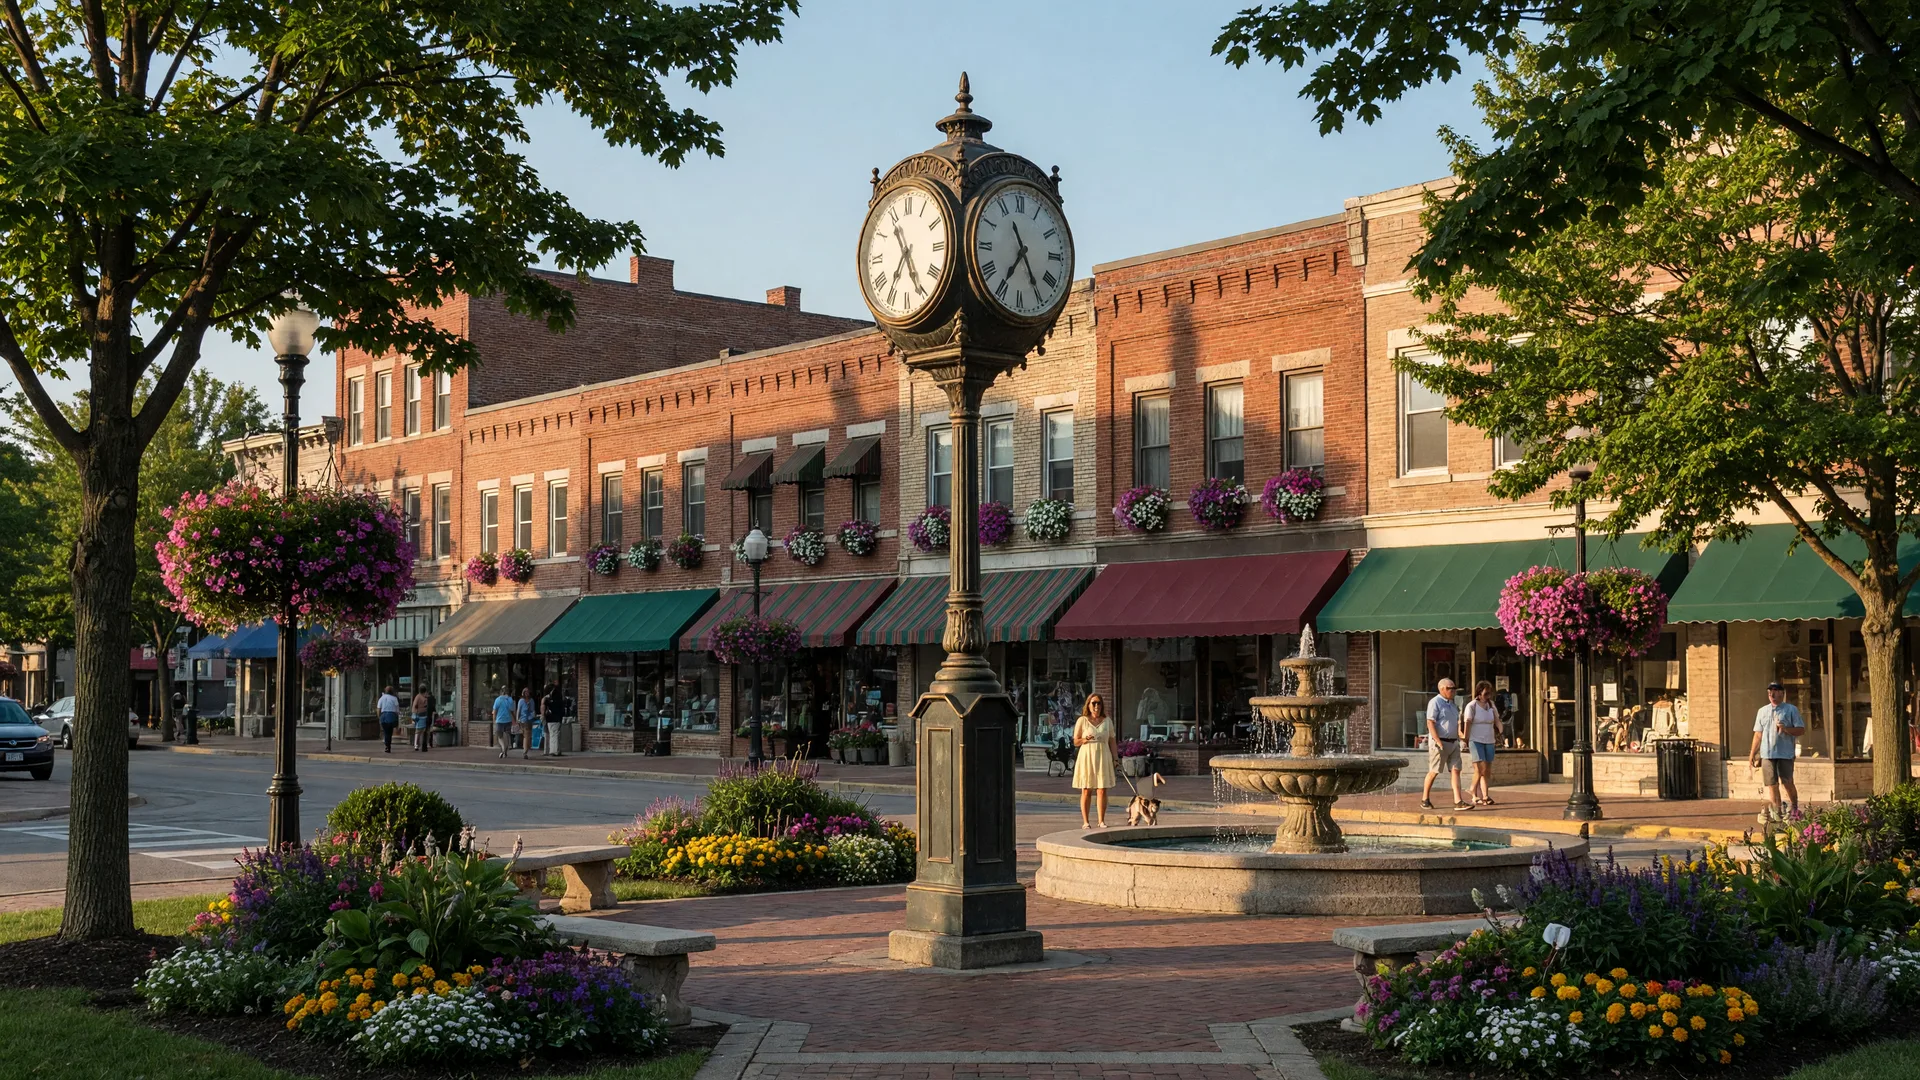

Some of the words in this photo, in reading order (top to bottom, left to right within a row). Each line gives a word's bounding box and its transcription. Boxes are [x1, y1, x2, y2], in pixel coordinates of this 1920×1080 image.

[919, 200, 927, 218] I
[996, 198, 1009, 218] XI
[1015, 196, 1024, 214] XII
[1033, 206, 1040, 220] I
[929, 216, 941, 231] II
[1043, 228, 1056, 240] II
[932, 241, 944, 252] III
[978, 241, 992, 251] IX
[1048, 251, 1061, 262] III
